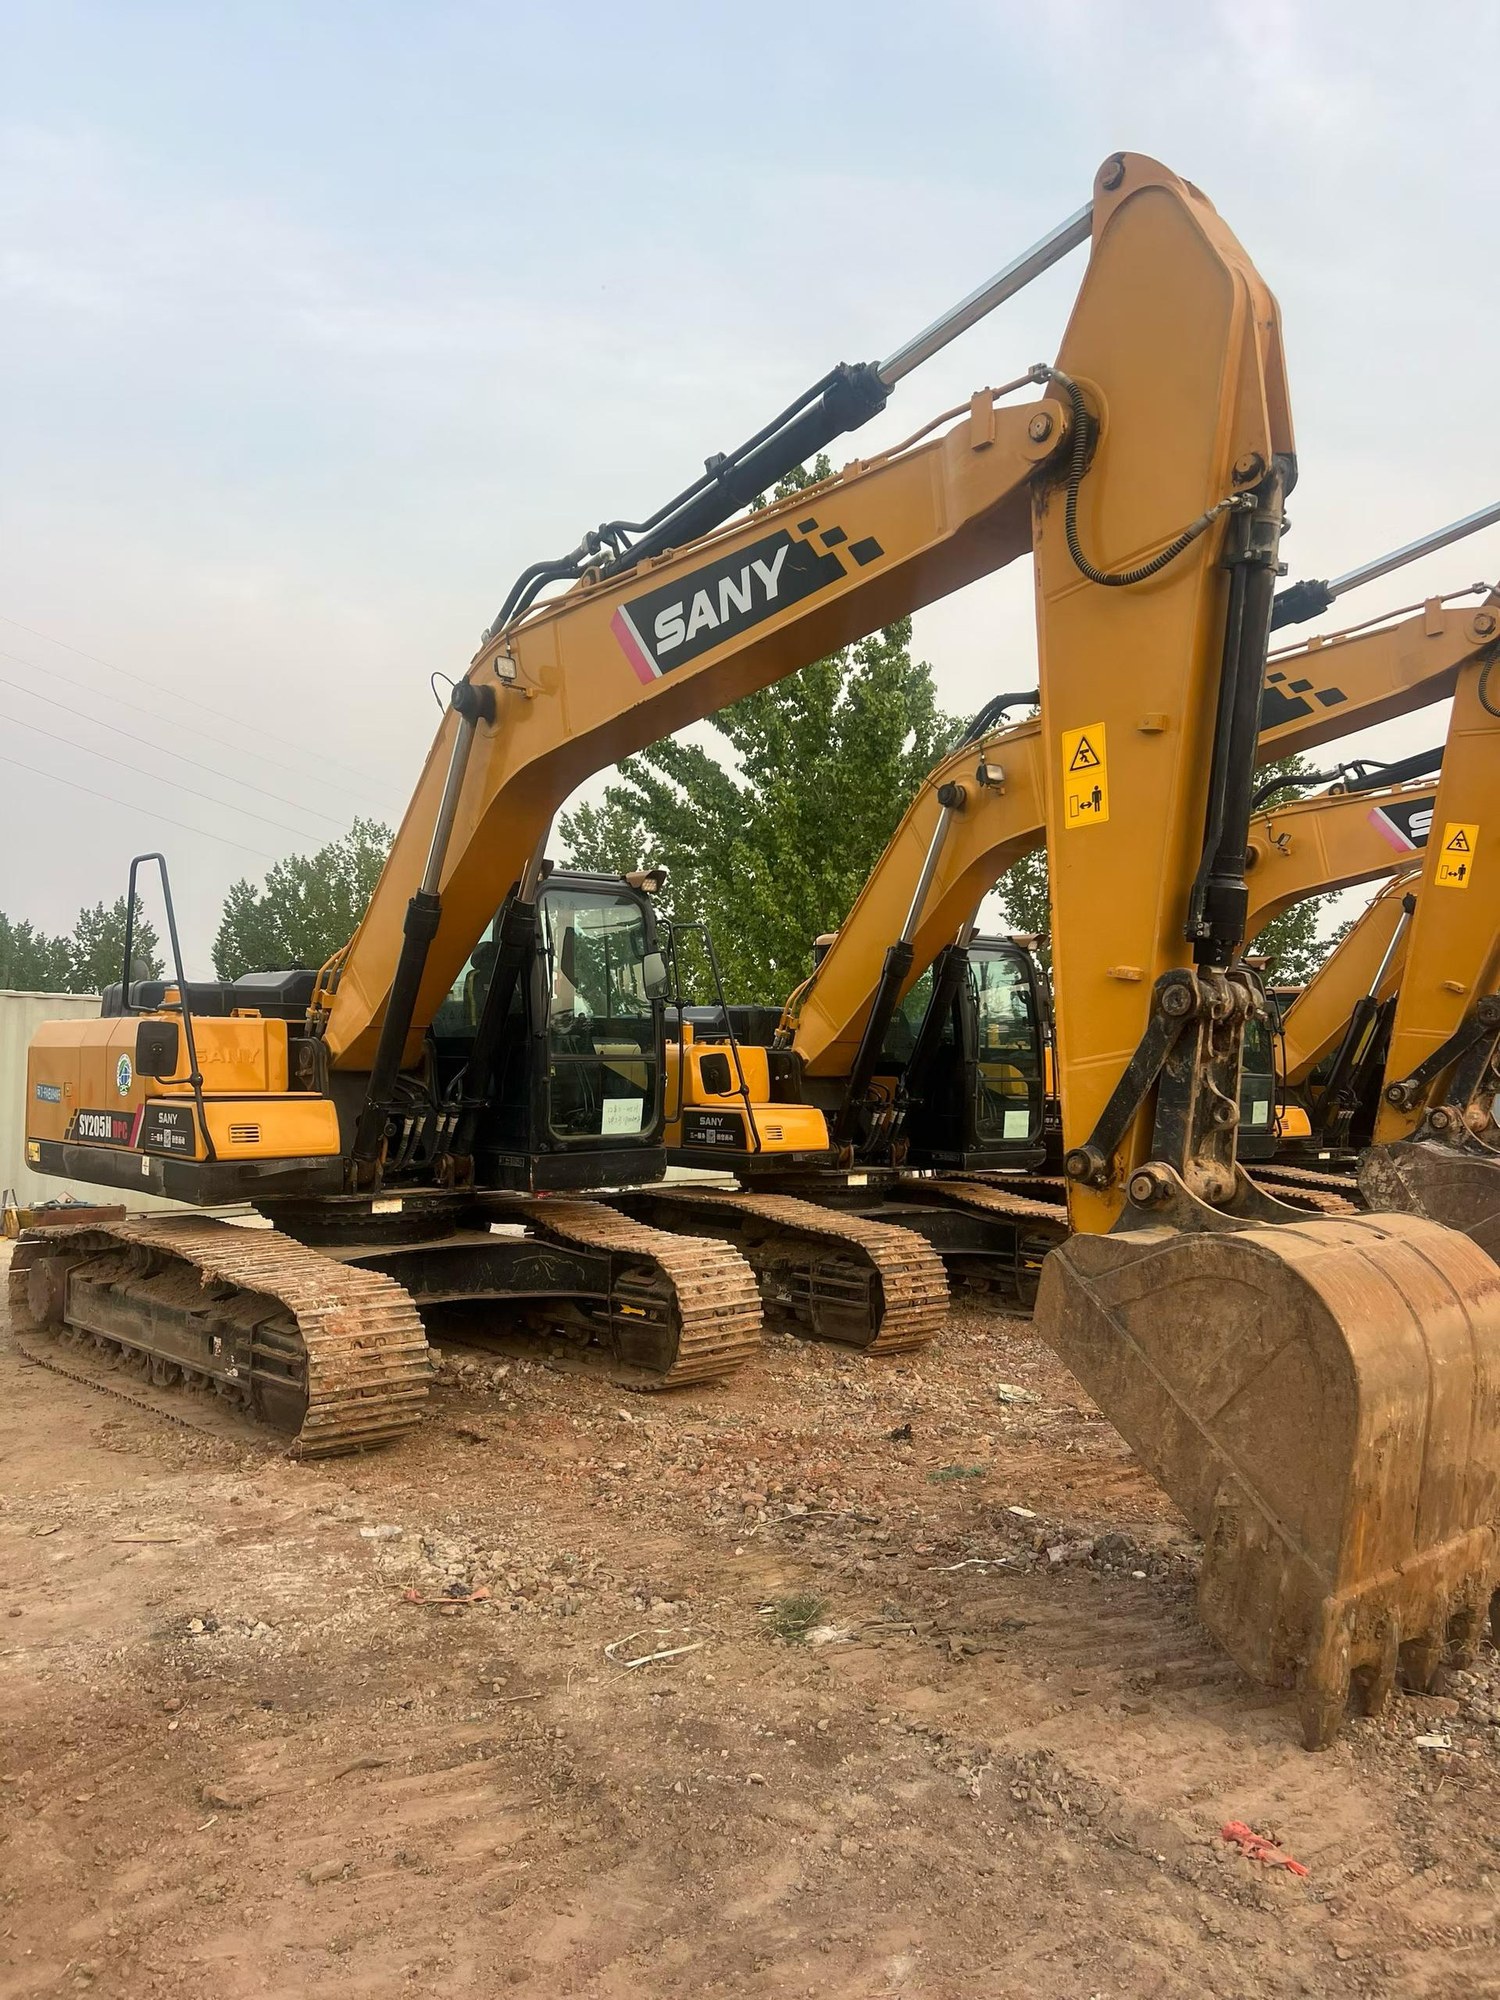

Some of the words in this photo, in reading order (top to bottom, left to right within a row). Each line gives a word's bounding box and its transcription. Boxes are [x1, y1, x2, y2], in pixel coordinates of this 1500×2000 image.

[654, 544, 789, 656] SANY
[194, 1047, 261, 1064] SANY
[79, 1113, 112, 1138] SY205H
[158, 1112, 178, 1125] SANY
[700, 1116, 724, 1126] SANY
